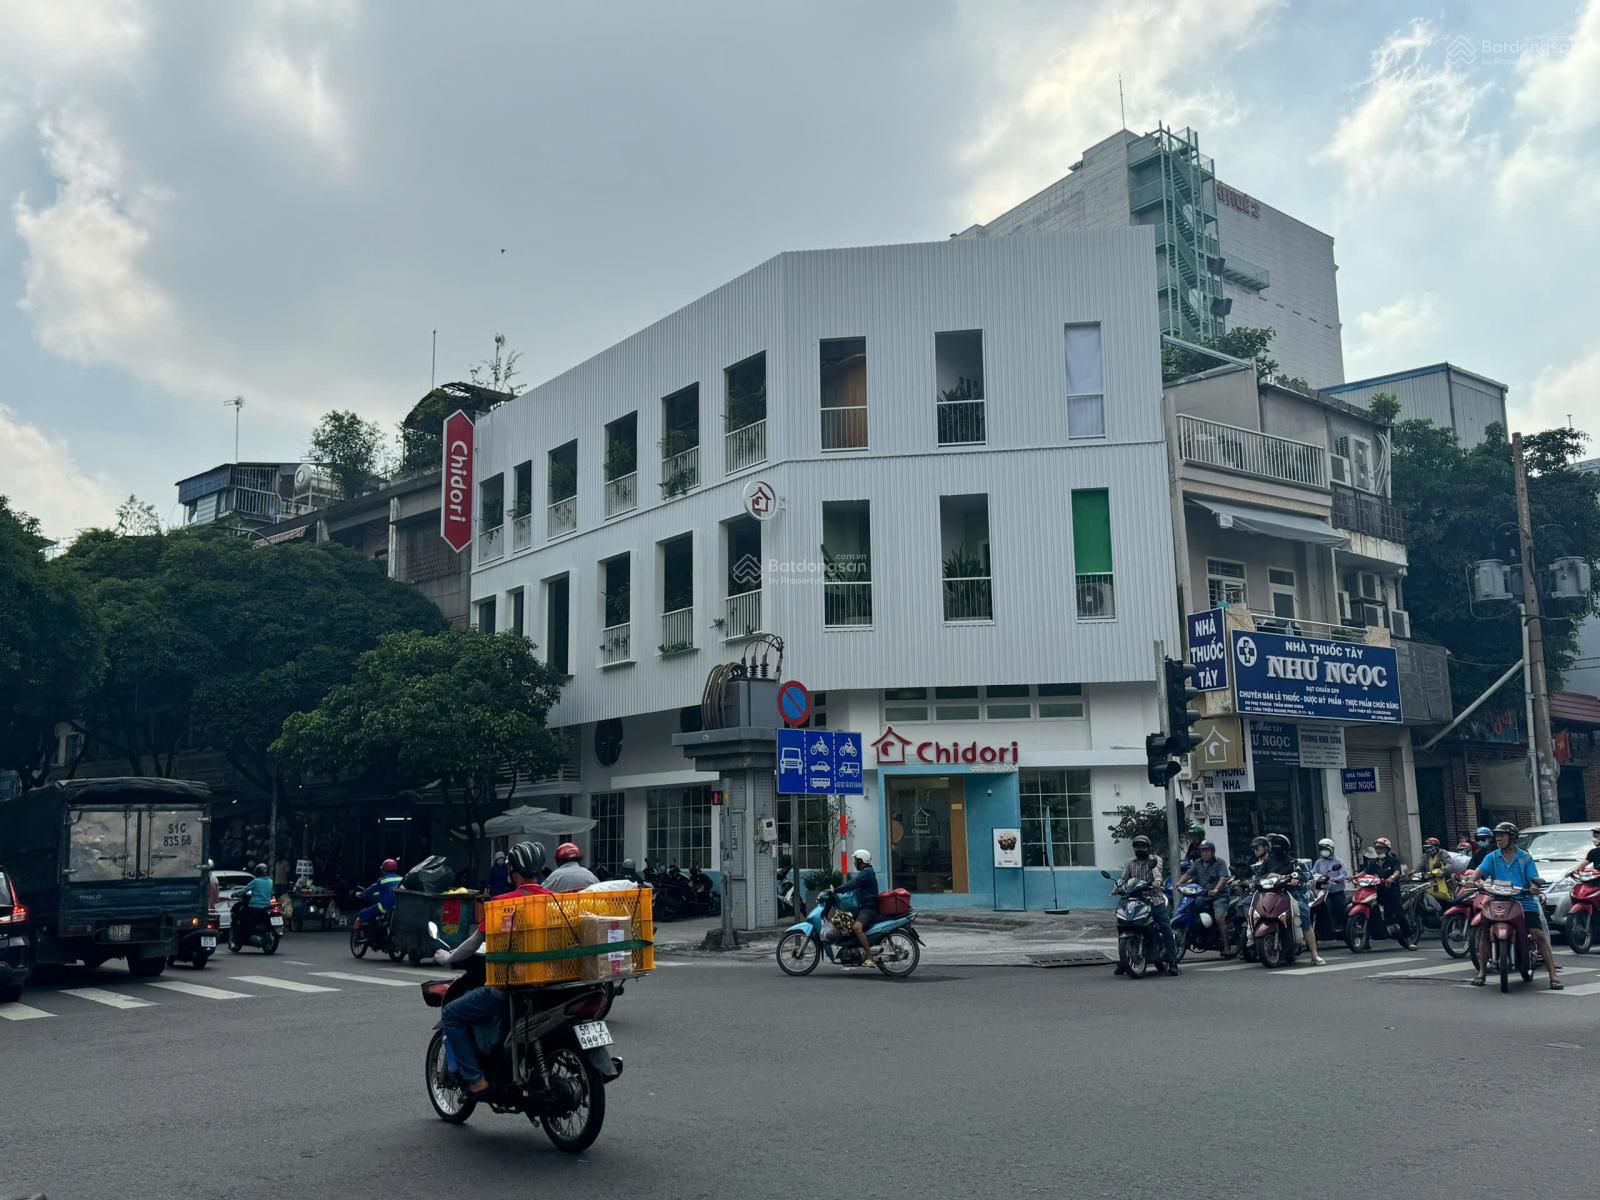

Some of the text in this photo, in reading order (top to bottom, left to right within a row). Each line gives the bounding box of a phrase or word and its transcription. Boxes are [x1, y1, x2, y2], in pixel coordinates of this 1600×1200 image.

[449, 440, 468, 523] Chidori
[1195, 613, 1216, 637] NHÀ
[1190, 636, 1224, 664] THUỐC
[1285, 640, 1363, 659] NHÀ THUỐC TÂY
[1199, 667, 1218, 688] TÂY
[1266, 655, 1388, 691] NHƯ NGỌC
[1239, 690, 1262, 699] CHUYÊN
[1263, 691, 1274, 700] BÁN
[1282, 692, 1300, 702] THUỐC
[1328, 695, 1342, 705] PHẨM
[1359, 697, 1372, 708] PHẨM
[1262, 734, 1290, 749] NGỌC
[917, 741, 1019, 764] Chidori
[1222, 780, 1241, 790] NHA
[168, 822, 187, 834] 51C
